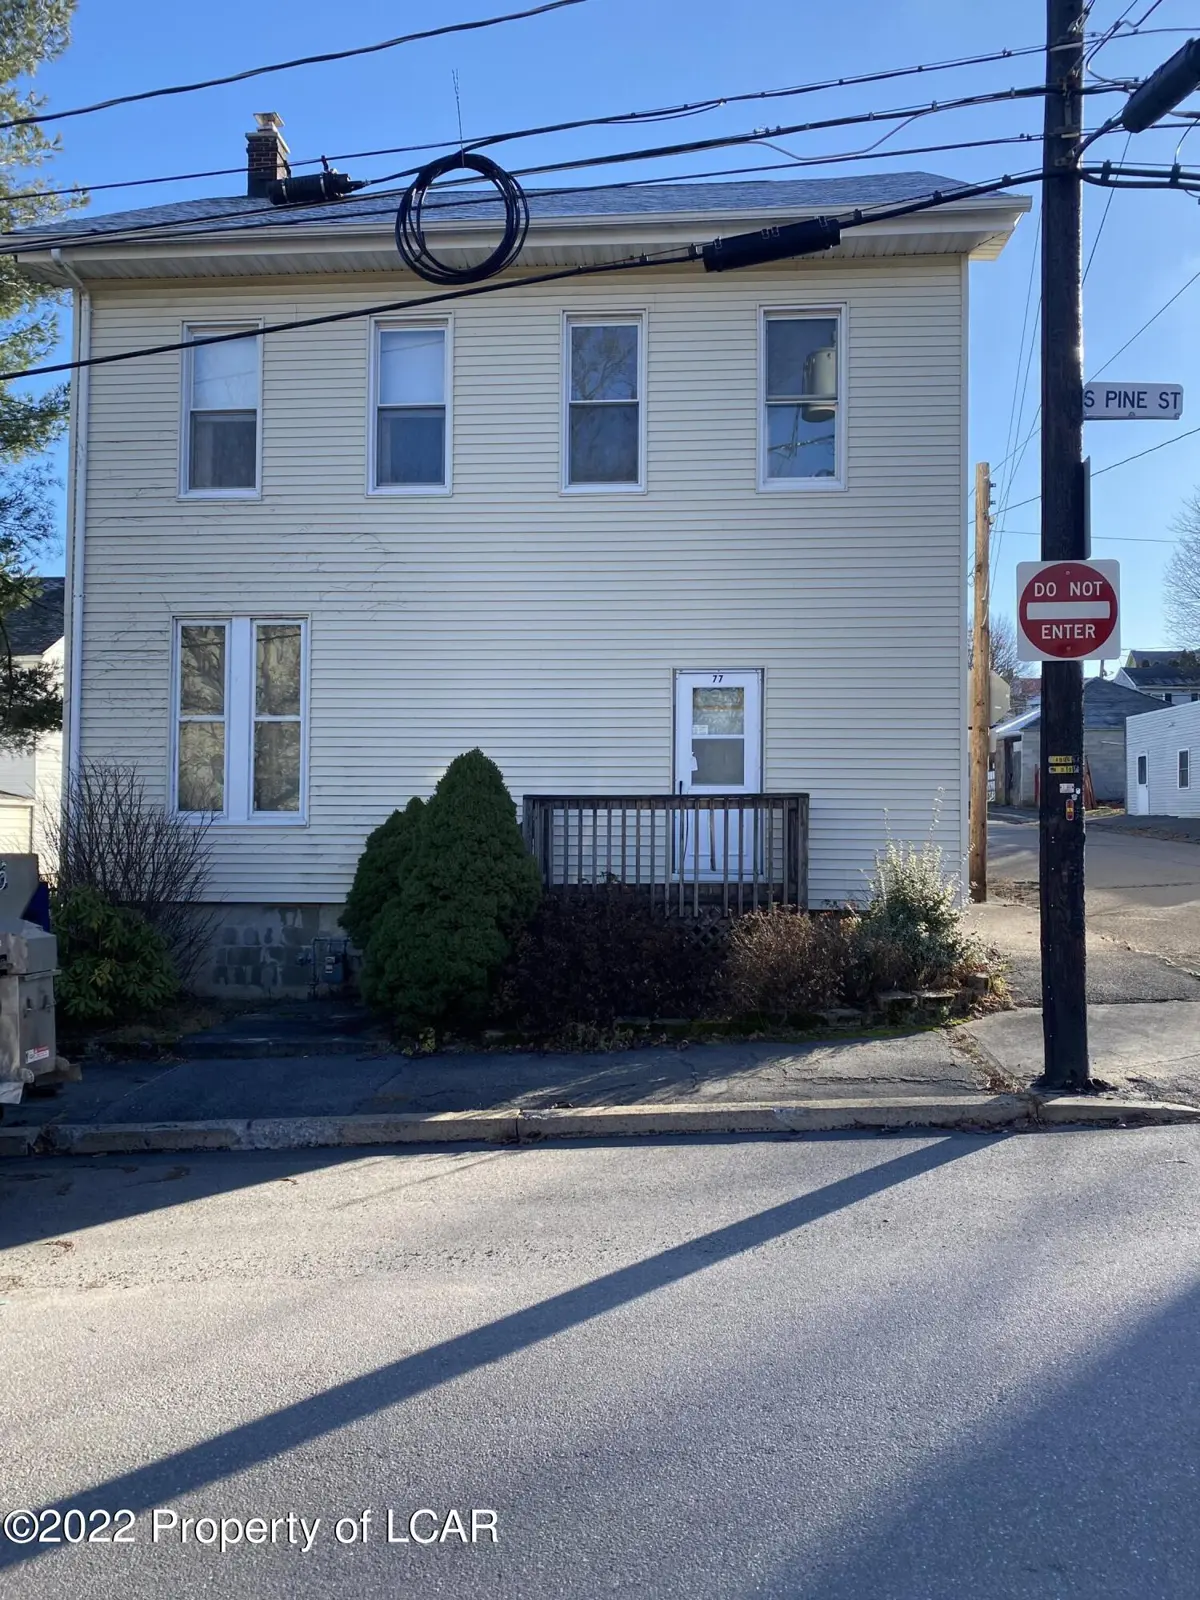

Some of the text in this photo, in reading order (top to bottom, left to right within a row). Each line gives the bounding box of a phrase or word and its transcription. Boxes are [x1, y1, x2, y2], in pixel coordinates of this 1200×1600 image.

[1083, 390, 1181, 410] S PINE ST
[1034, 581, 1103, 597] DO NOT
[1041, 624, 1096, 639] ENTER
[712, 675, 724, 683] 77
